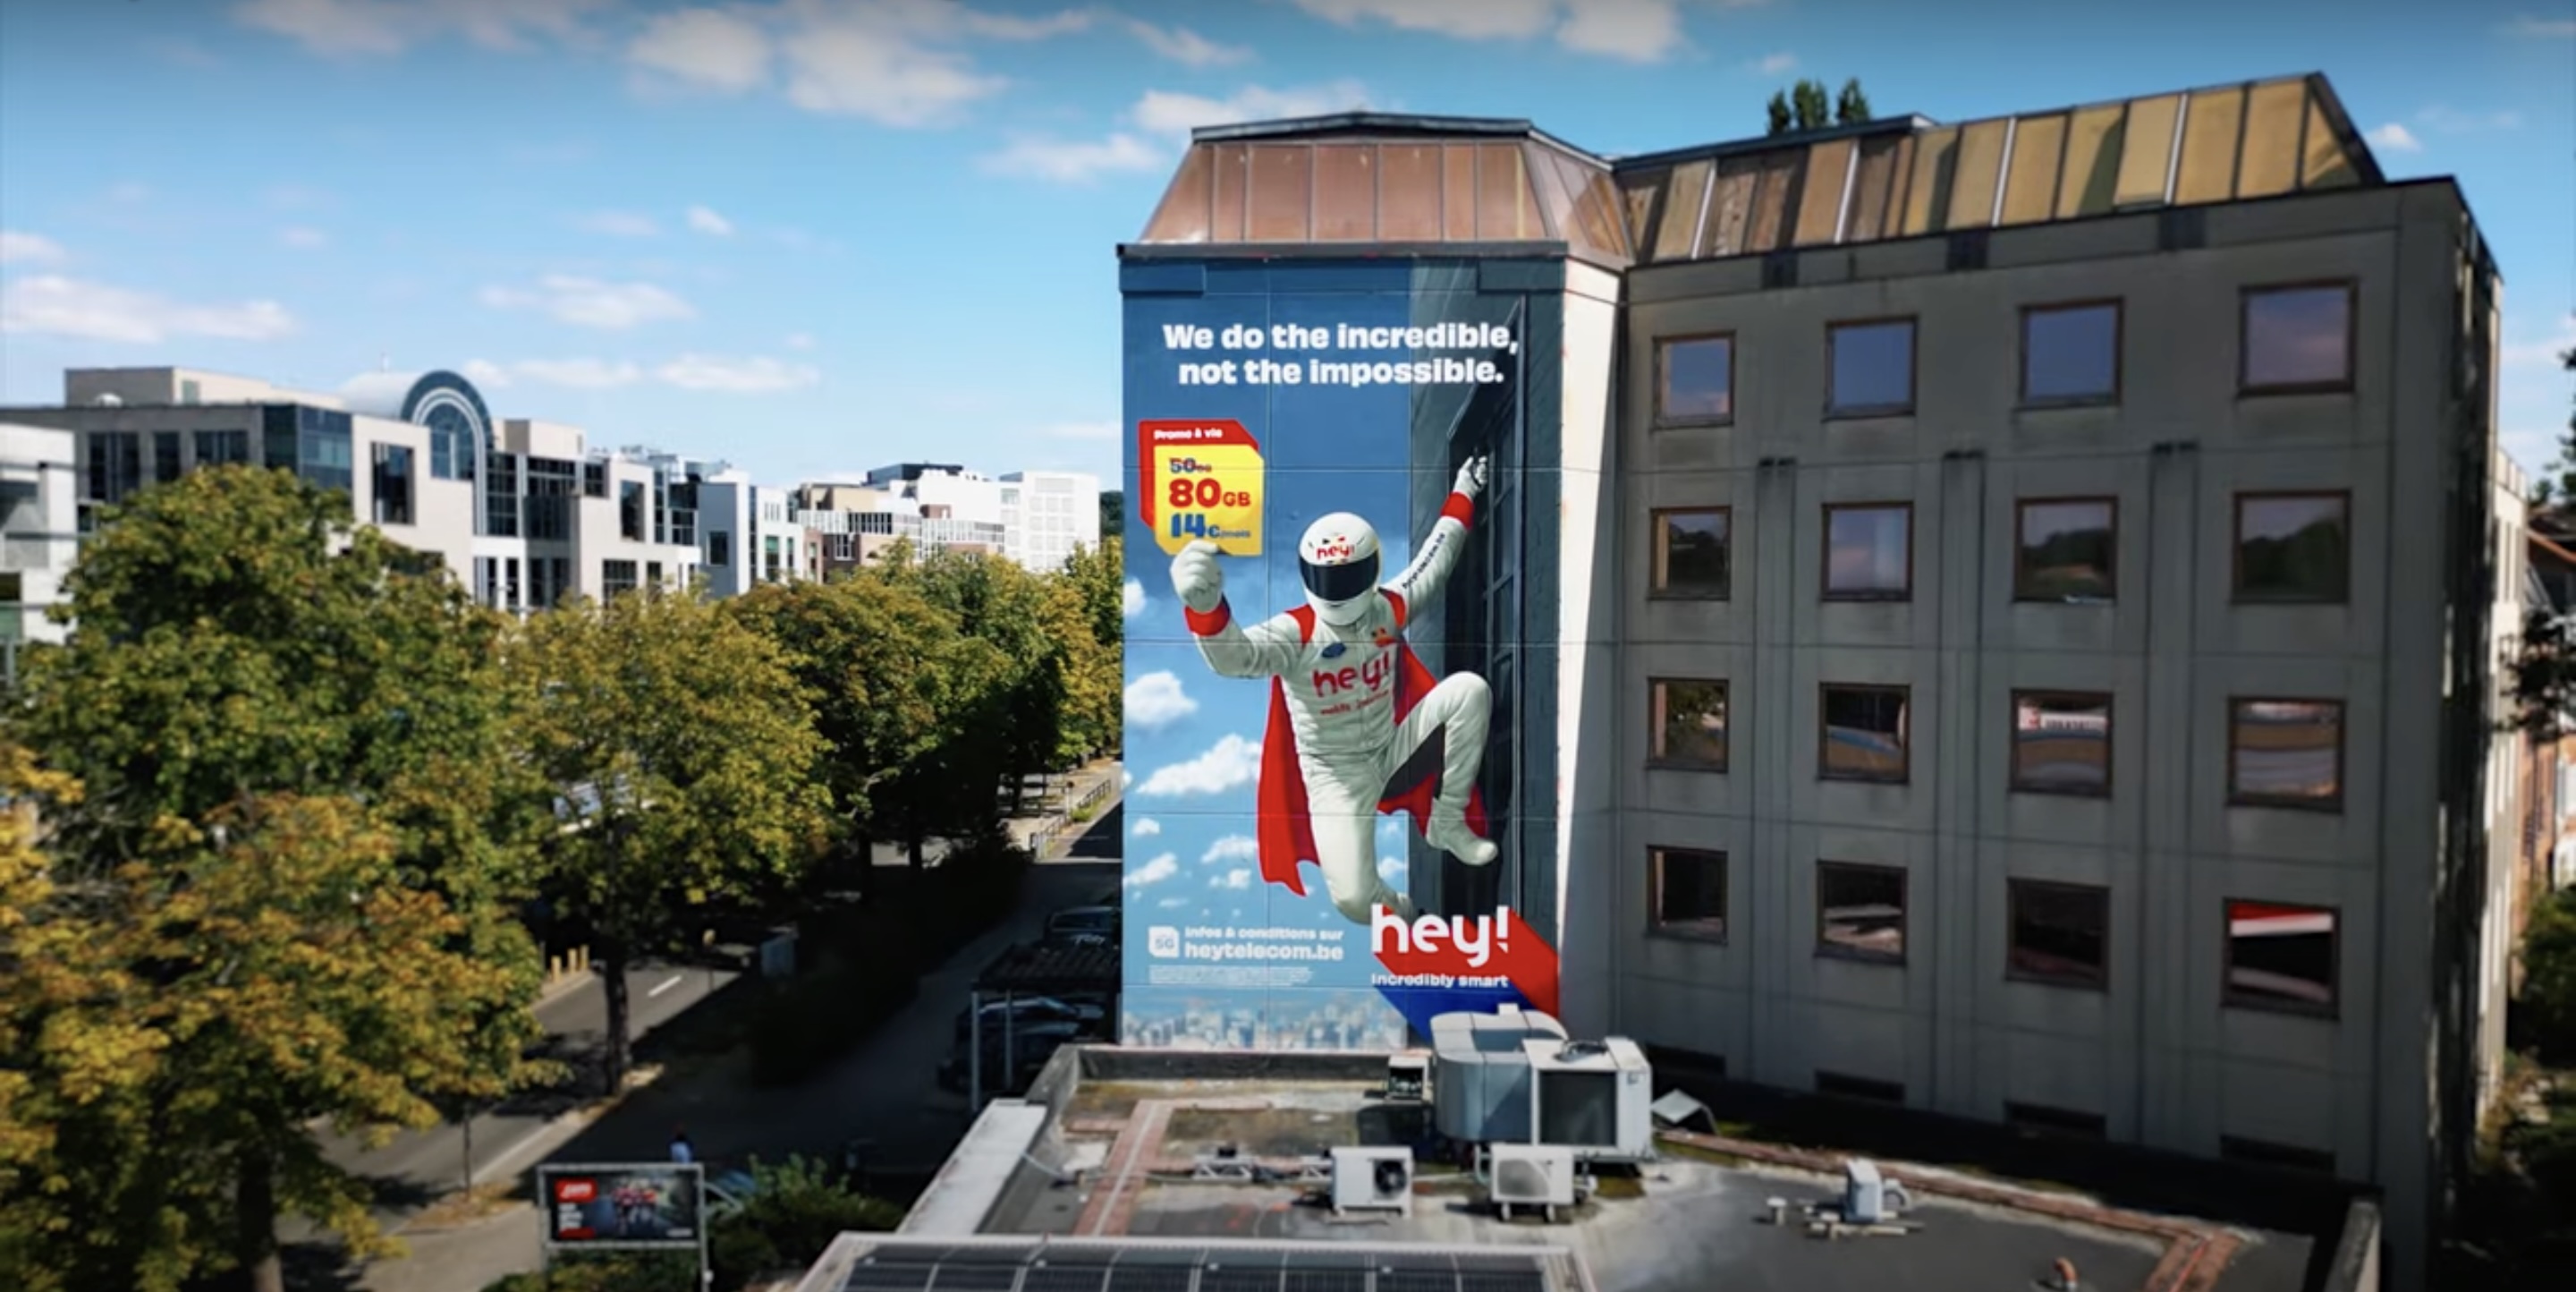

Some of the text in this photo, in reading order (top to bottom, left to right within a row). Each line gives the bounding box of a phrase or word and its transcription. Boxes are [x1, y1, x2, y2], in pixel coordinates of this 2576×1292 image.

[1163, 322, 1518, 354] We do the incredible,
[1179, 358, 1504, 387] not the impossible.
[1312, 651, 1389, 698] hey!
[1239, 927, 1317, 940] conditions
[1320, 929, 1343, 940] sur
[1371, 904, 1509, 967] hey!
[1184, 941, 1343, 961] heytelecom.be
[1458, 975, 1509, 988] smart
